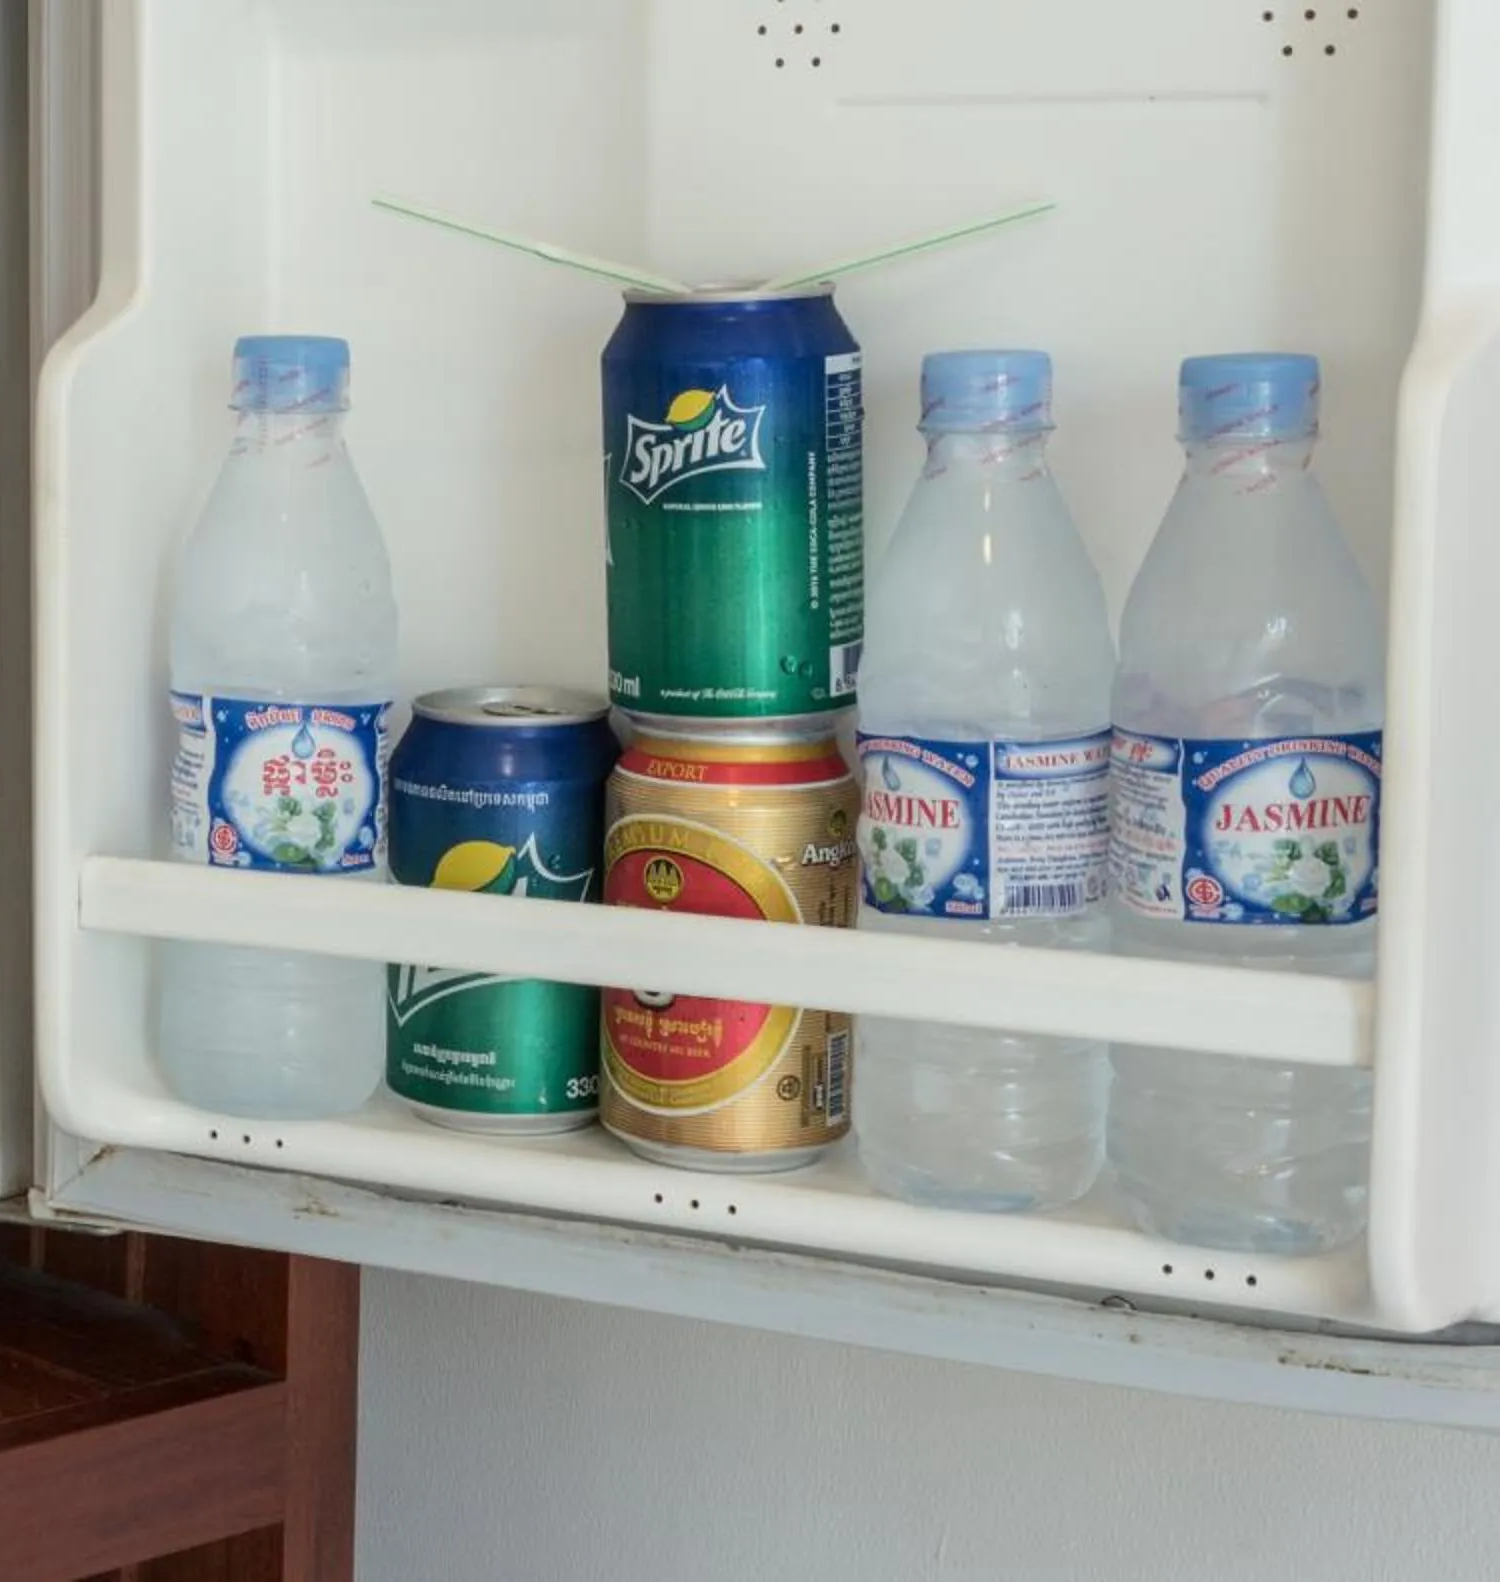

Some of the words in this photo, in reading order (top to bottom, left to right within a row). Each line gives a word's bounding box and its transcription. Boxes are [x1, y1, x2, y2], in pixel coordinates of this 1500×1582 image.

[630, 411, 747, 490] Sprite
[623, 675, 641, 697] ml
[647, 759, 709, 781] EXPORT
[1005, 751, 1078, 769] JASMINE
[868, 789, 961, 829] SMINE
[1215, 795, 1371, 833] JASMINE
